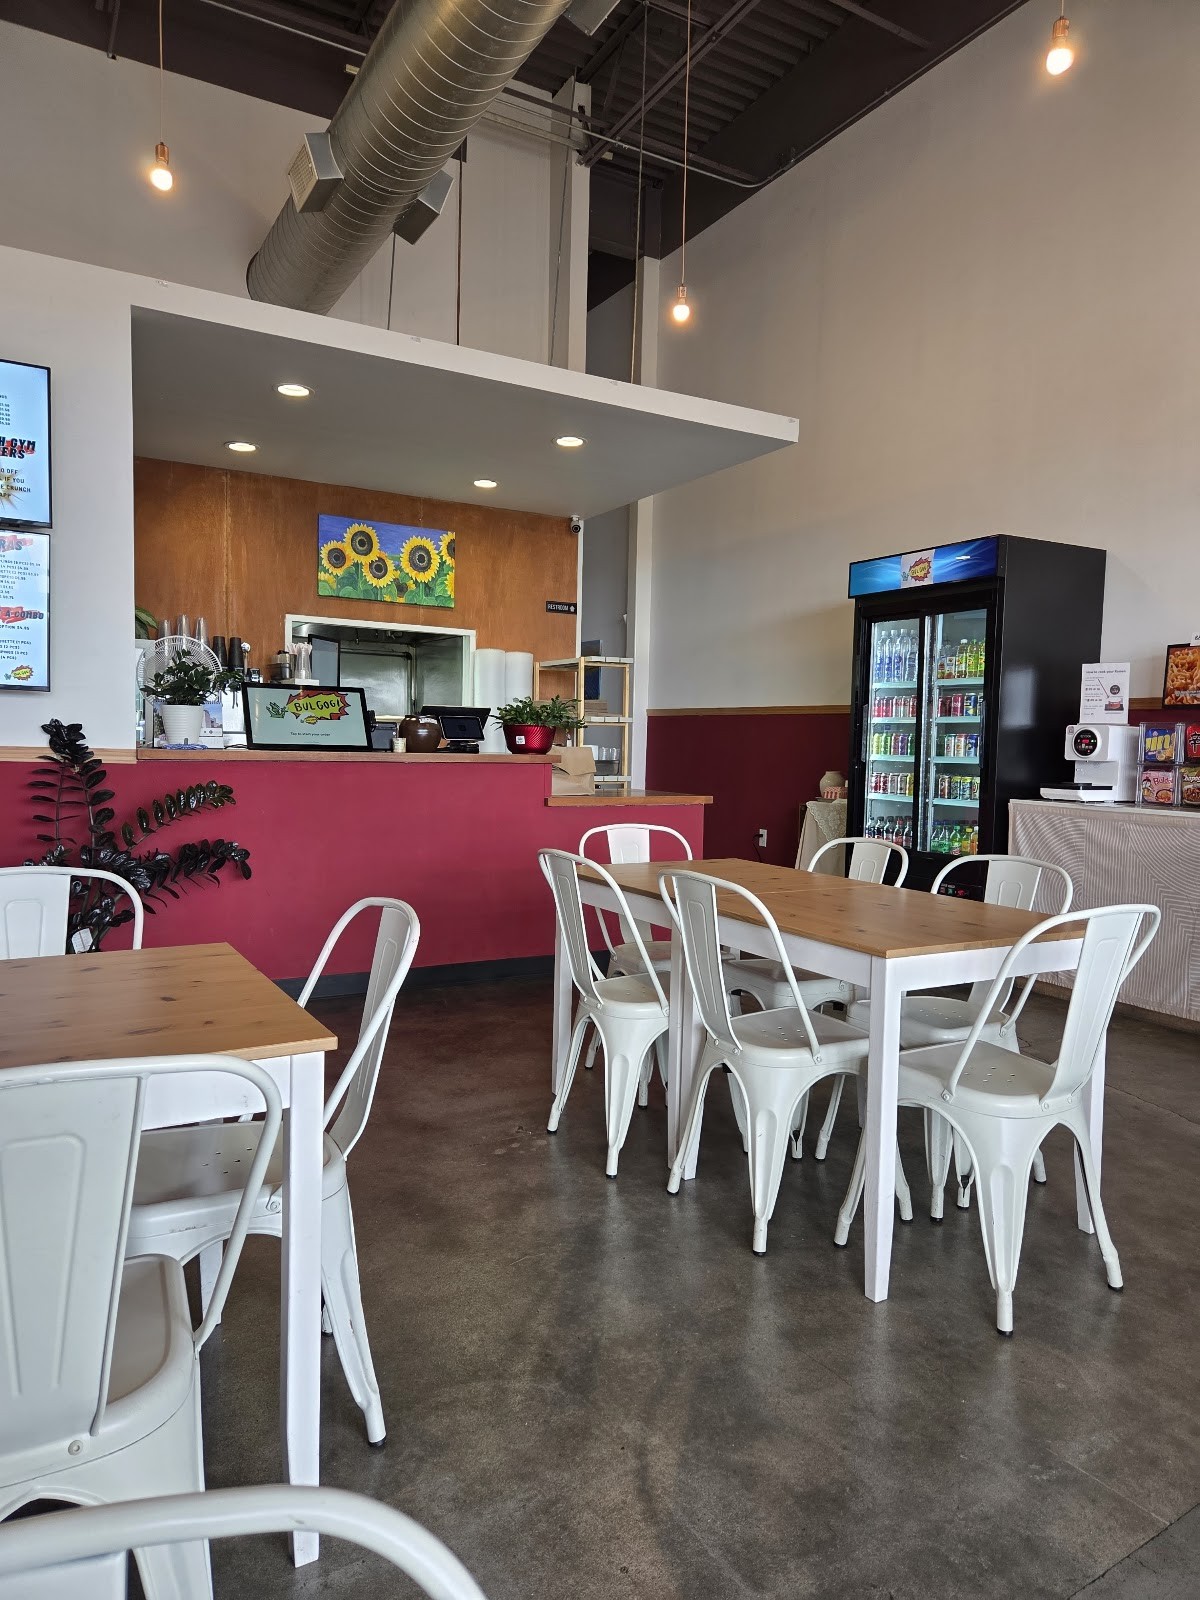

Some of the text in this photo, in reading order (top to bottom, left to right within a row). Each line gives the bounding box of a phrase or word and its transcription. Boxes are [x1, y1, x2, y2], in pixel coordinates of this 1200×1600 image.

[11, 438, 36, 451] GYM
[6, 484, 31, 493] CRUNCH
[547, 603, 569, 611] RESTROOM
[14, 610, 44, 620] COMBO
